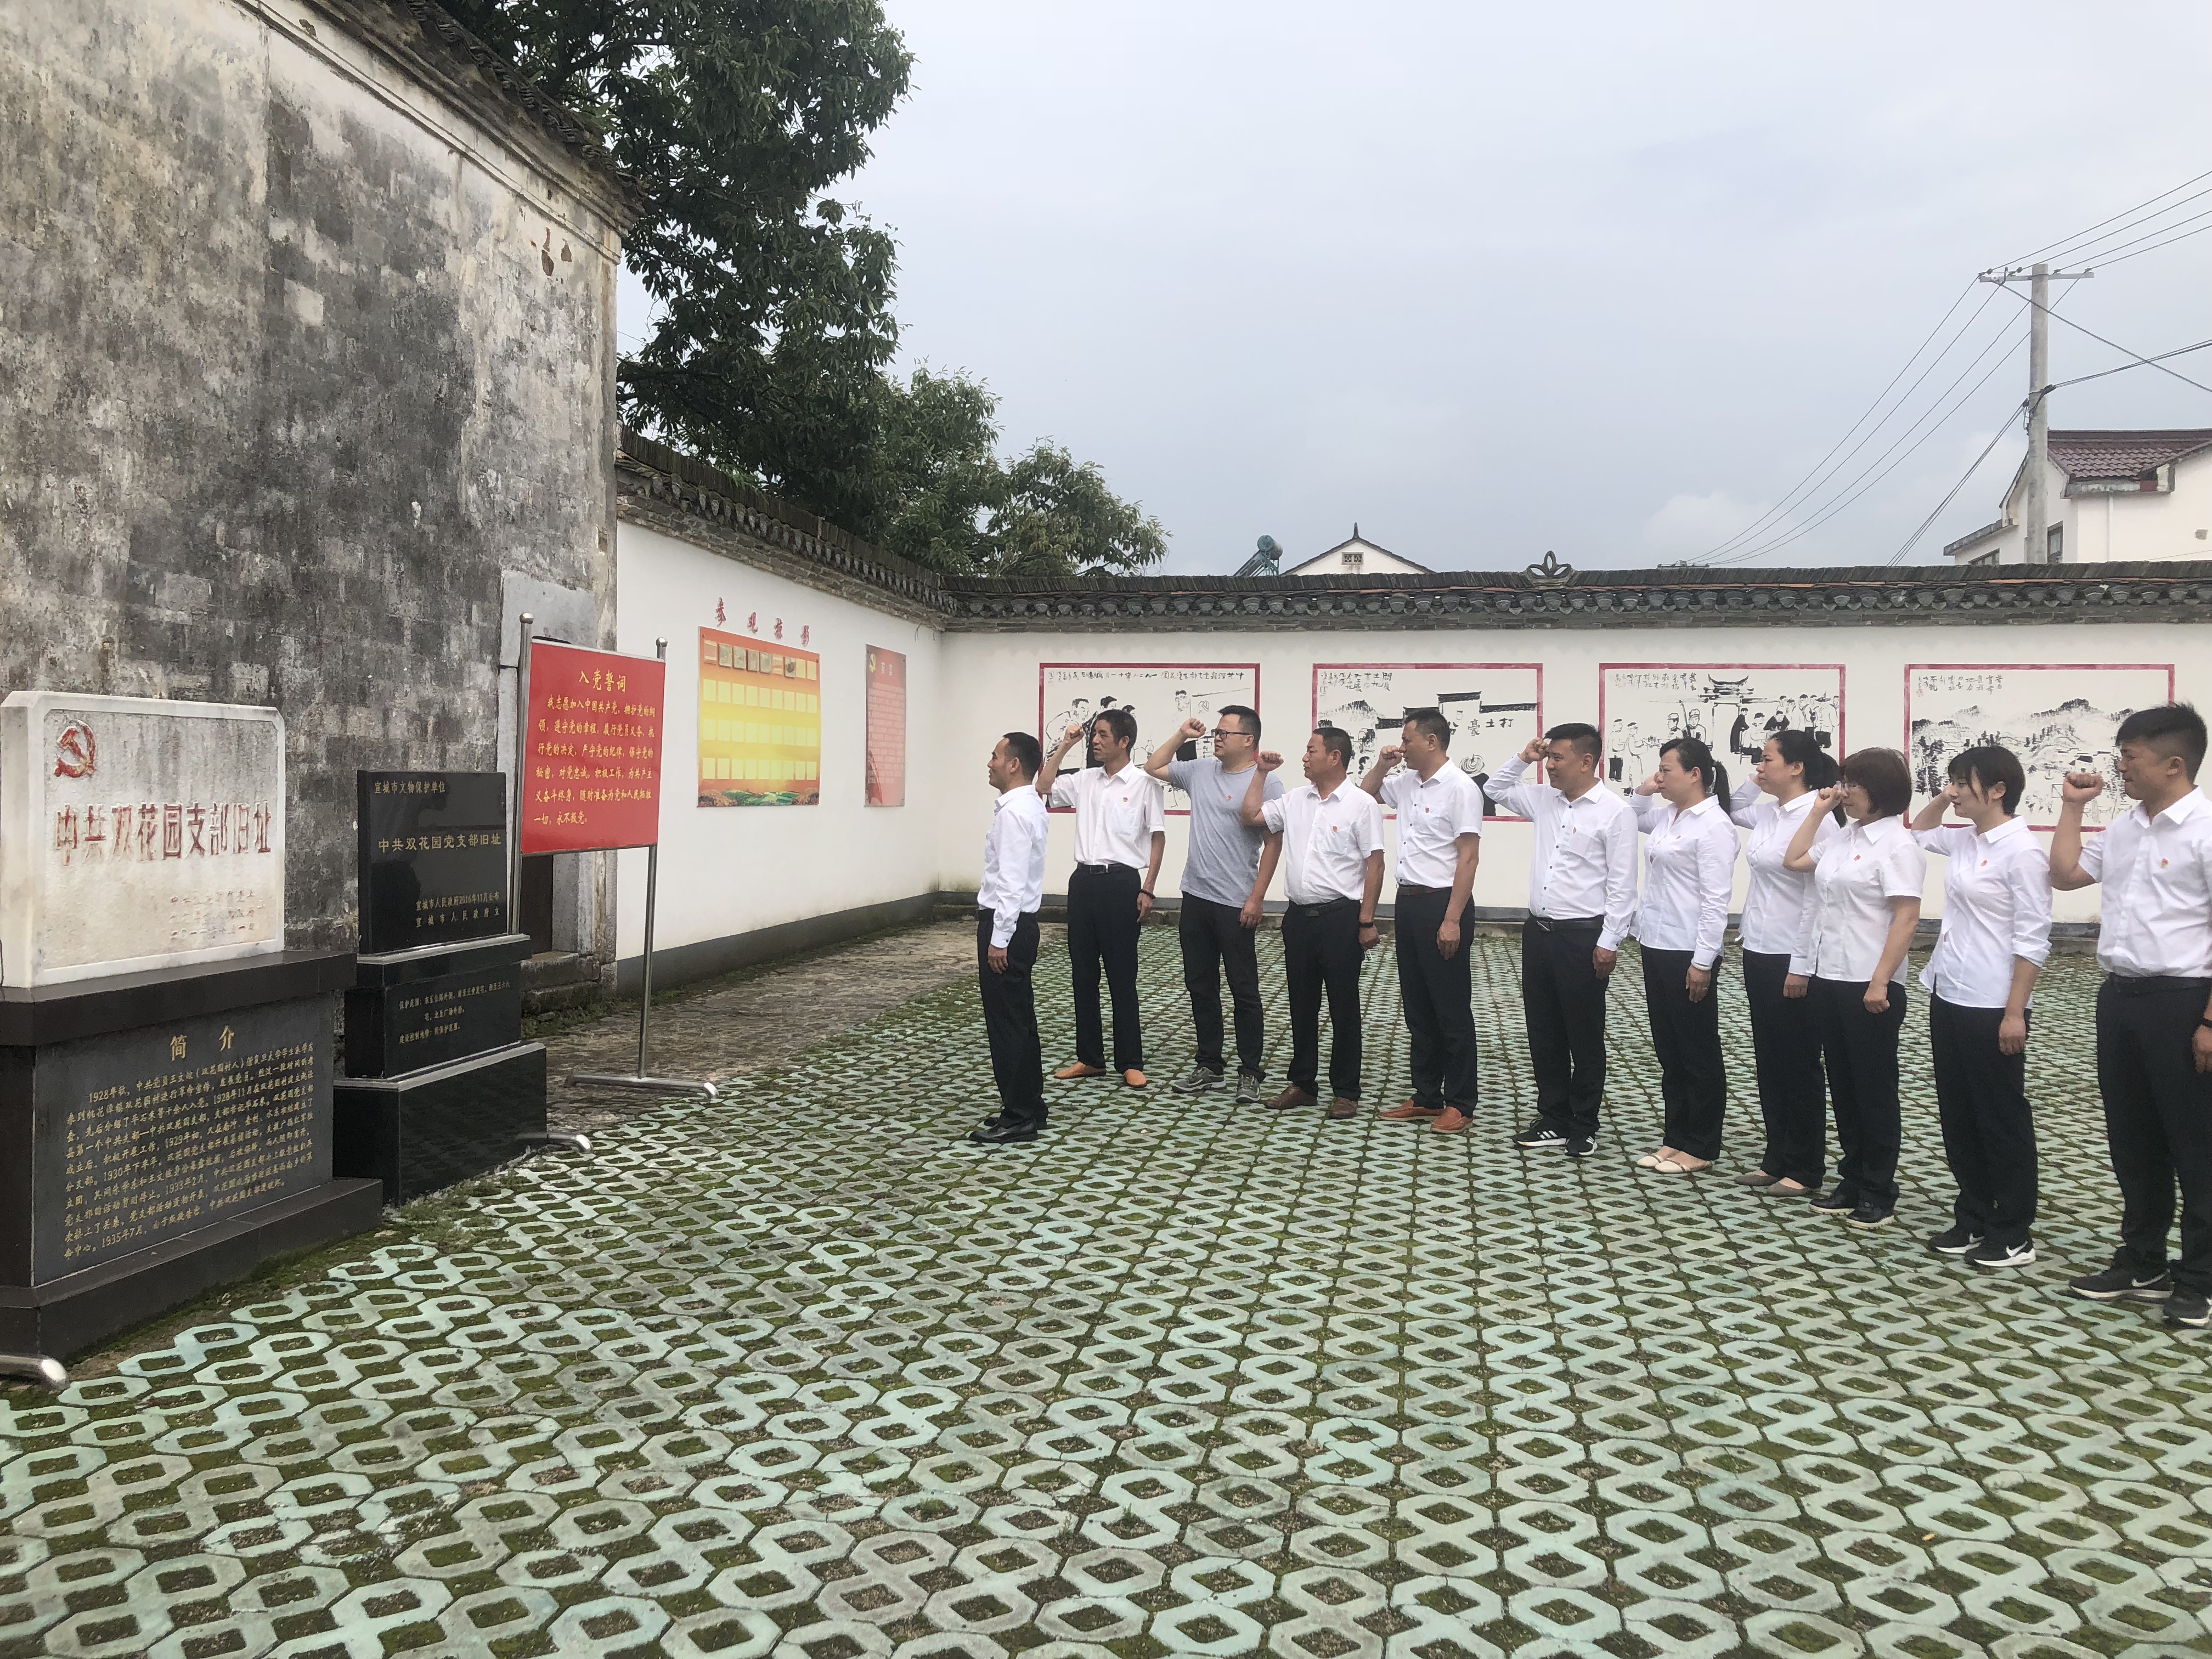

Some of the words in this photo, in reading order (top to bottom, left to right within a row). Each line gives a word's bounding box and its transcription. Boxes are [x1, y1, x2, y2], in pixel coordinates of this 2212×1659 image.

[578, 668, 627, 693] 入党誓词
[547, 694, 656, 718] 我志愿加入中国共产党，拥护党的纲
[538, 719, 654, 738] 领，遵守党的章程，履行党员义务，执
[537, 742, 653, 759] 行党的决定，严守党的纪律，保守党的
[535, 766, 652, 780] 秘密，对党忠诚，积极工作，为共产主
[374, 781, 445, 794] 宣城市文物保护单位
[535, 788, 652, 803] 义奋斗终身，随时准备为党和人民牺牲
[534, 811, 588, 826] 一切，永不叛党。
[54, 802, 272, 866] 中共双花园支部旧址
[378, 833, 501, 853] 中共双花园党支部旧址
[416, 890, 500, 911] 宣城市人民政府2016年11月公布
[170, 1025, 235, 1062] 简介
